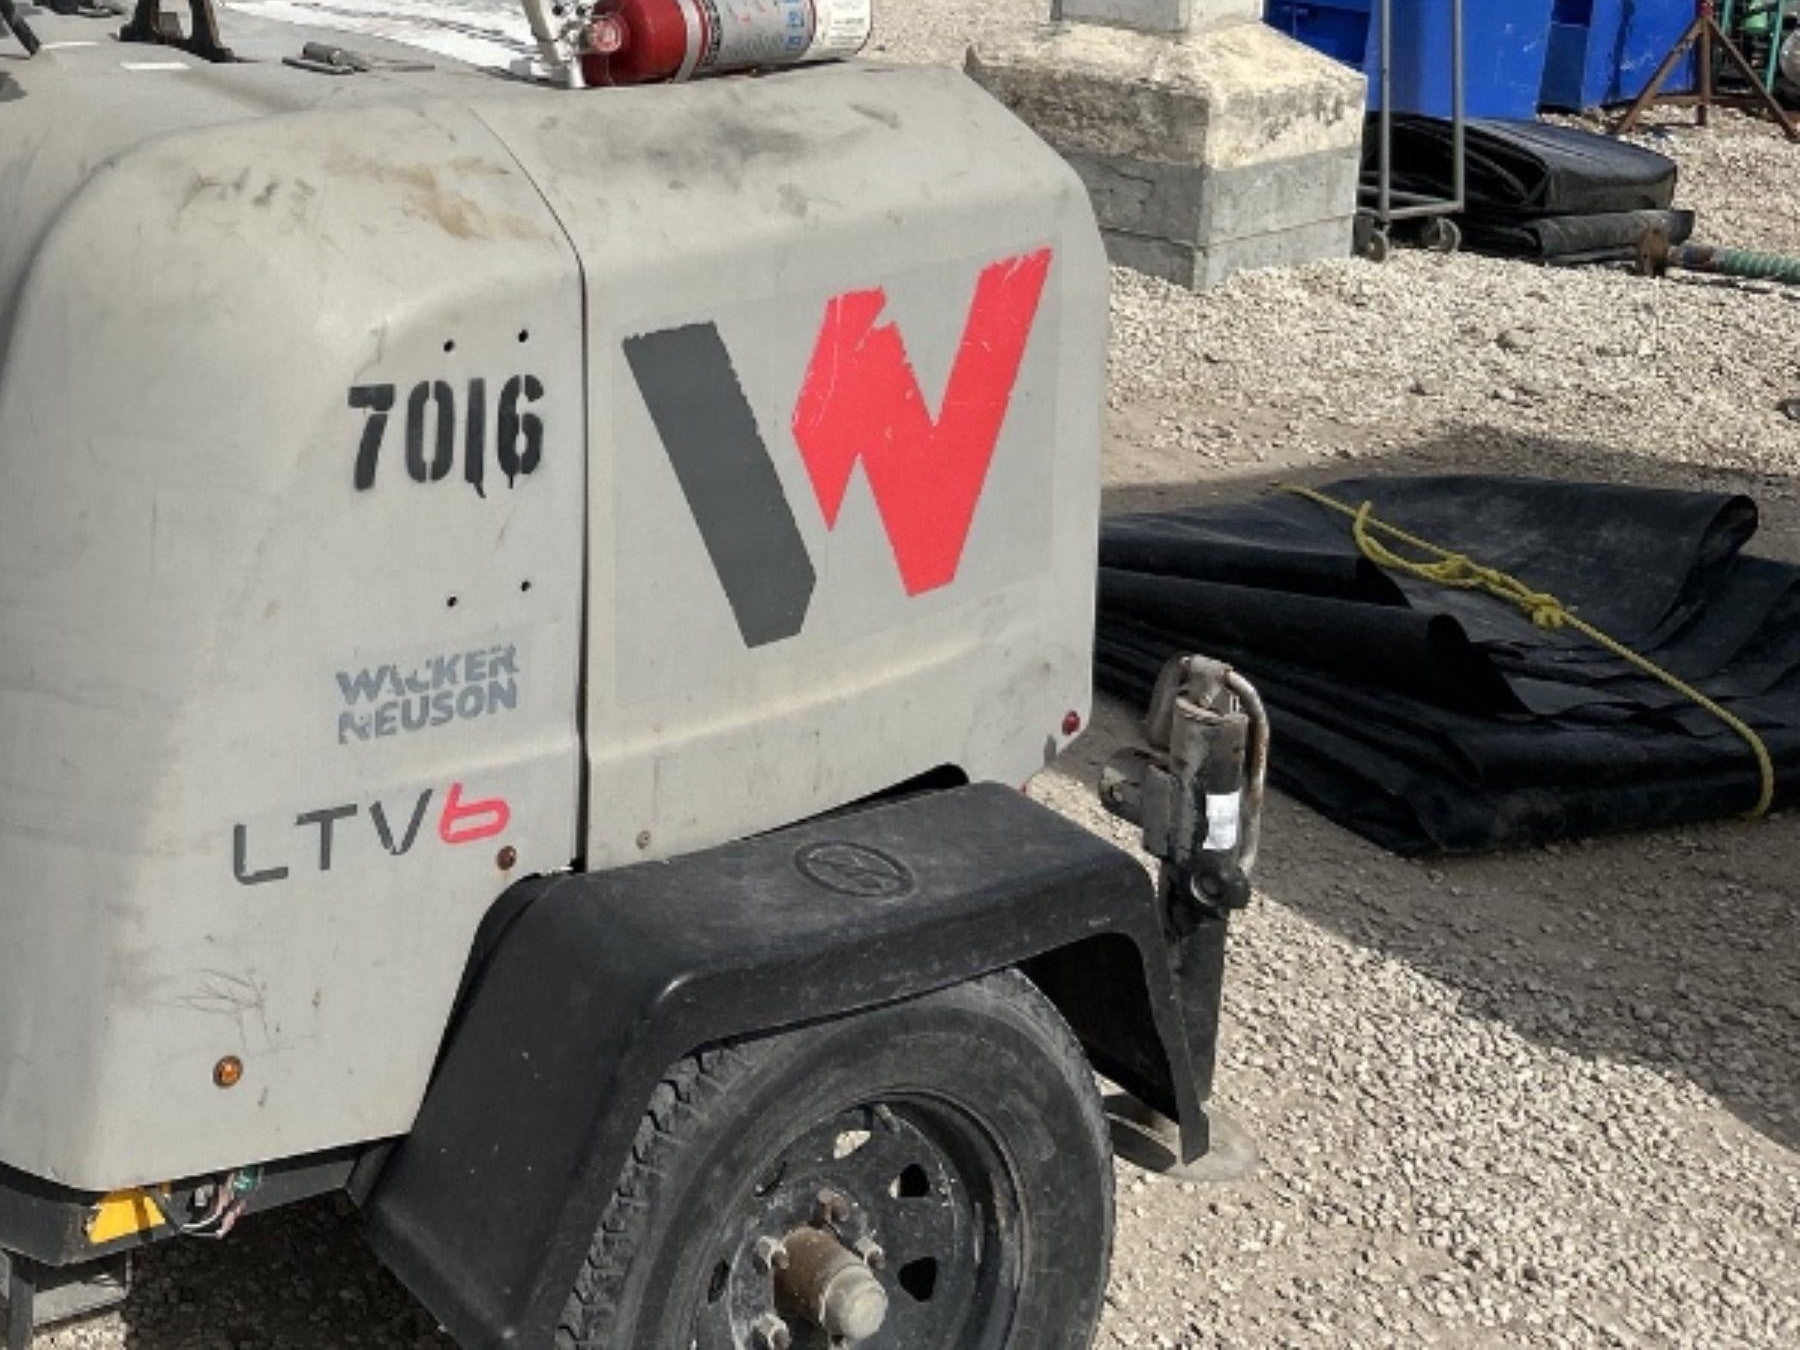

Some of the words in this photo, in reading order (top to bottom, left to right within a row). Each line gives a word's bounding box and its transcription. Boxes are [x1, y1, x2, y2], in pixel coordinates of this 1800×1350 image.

[348, 374, 545, 491] 7016
[338, 678, 518, 744] NEUSON
[232, 782, 511, 885] LTV6
